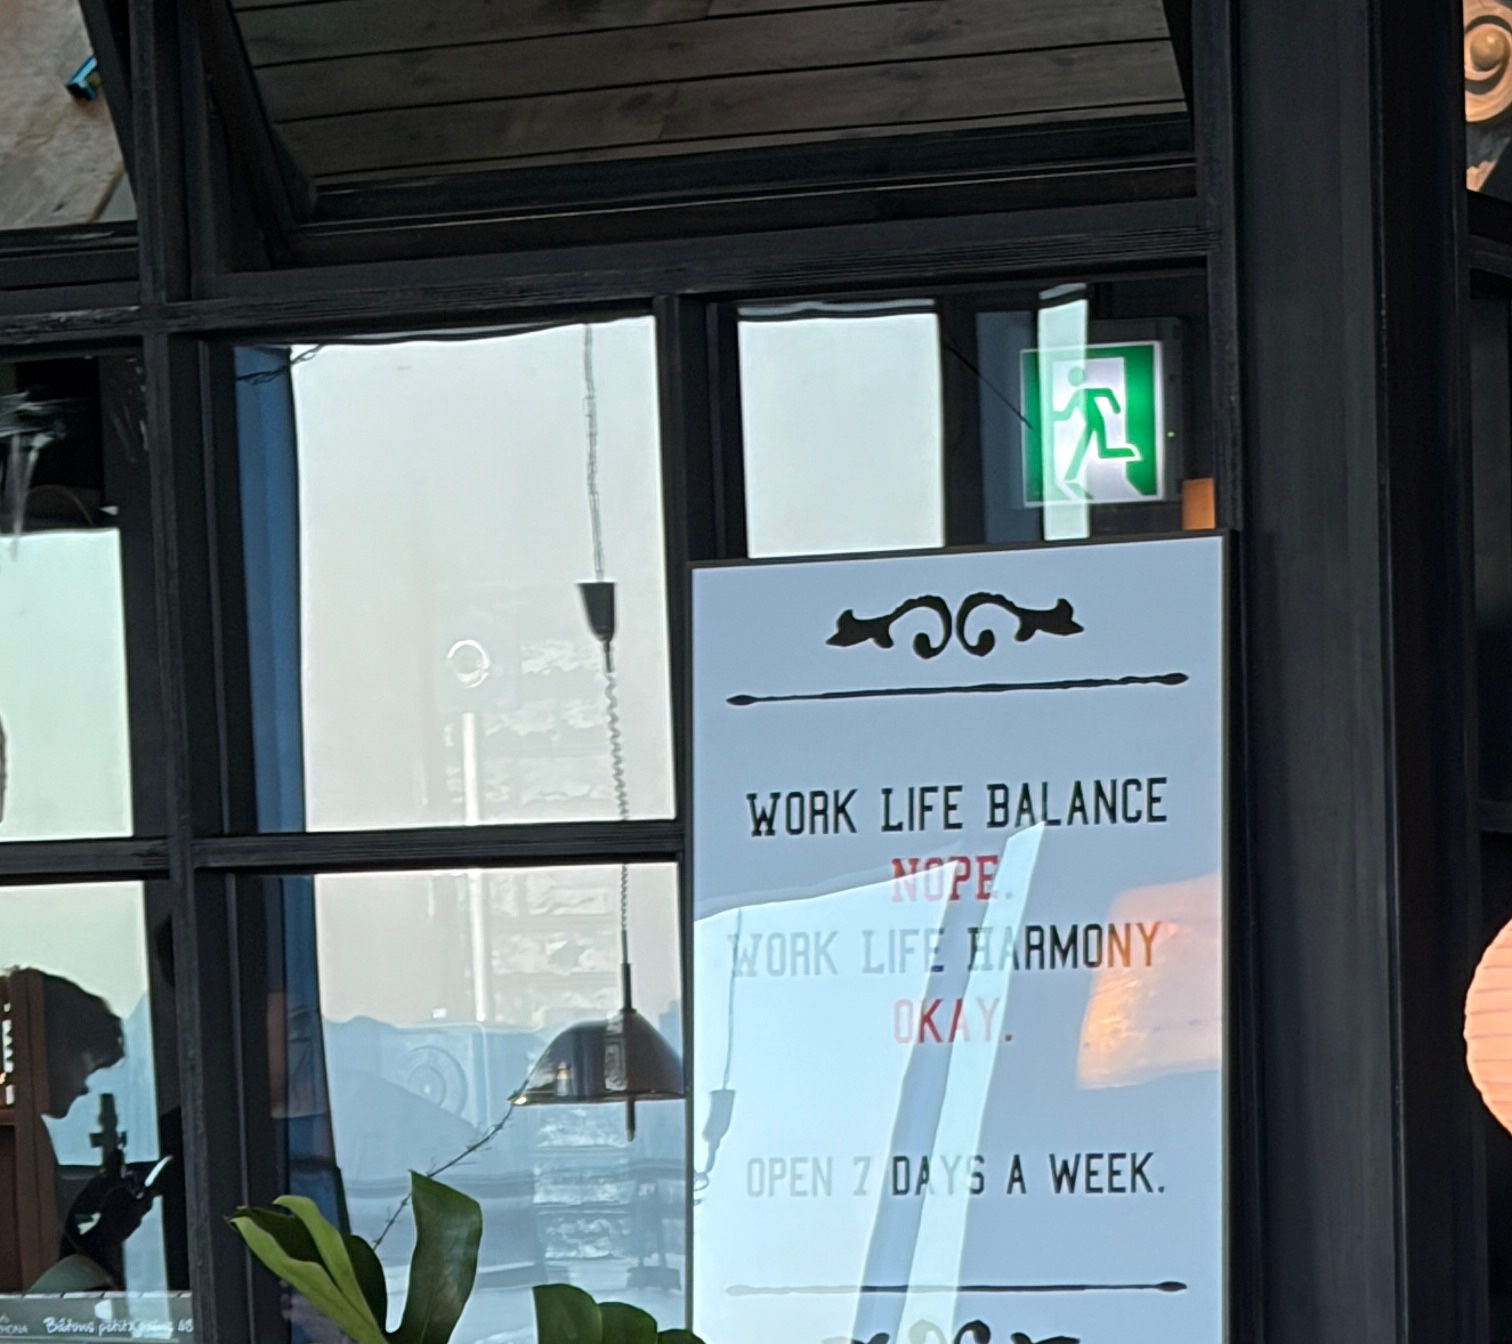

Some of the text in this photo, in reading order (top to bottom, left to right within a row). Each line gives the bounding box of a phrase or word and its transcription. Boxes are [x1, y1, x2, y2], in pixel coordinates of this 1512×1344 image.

[745, 776, 1169, 838] WORK LIFE BALANCE
[727, 920, 1163, 979] WORK LIFE HARMONY
[892, 997, 1014, 1045] OKAY.
[746, 1151, 1167, 1199] OPEN 7 DAYS A WEEK.
